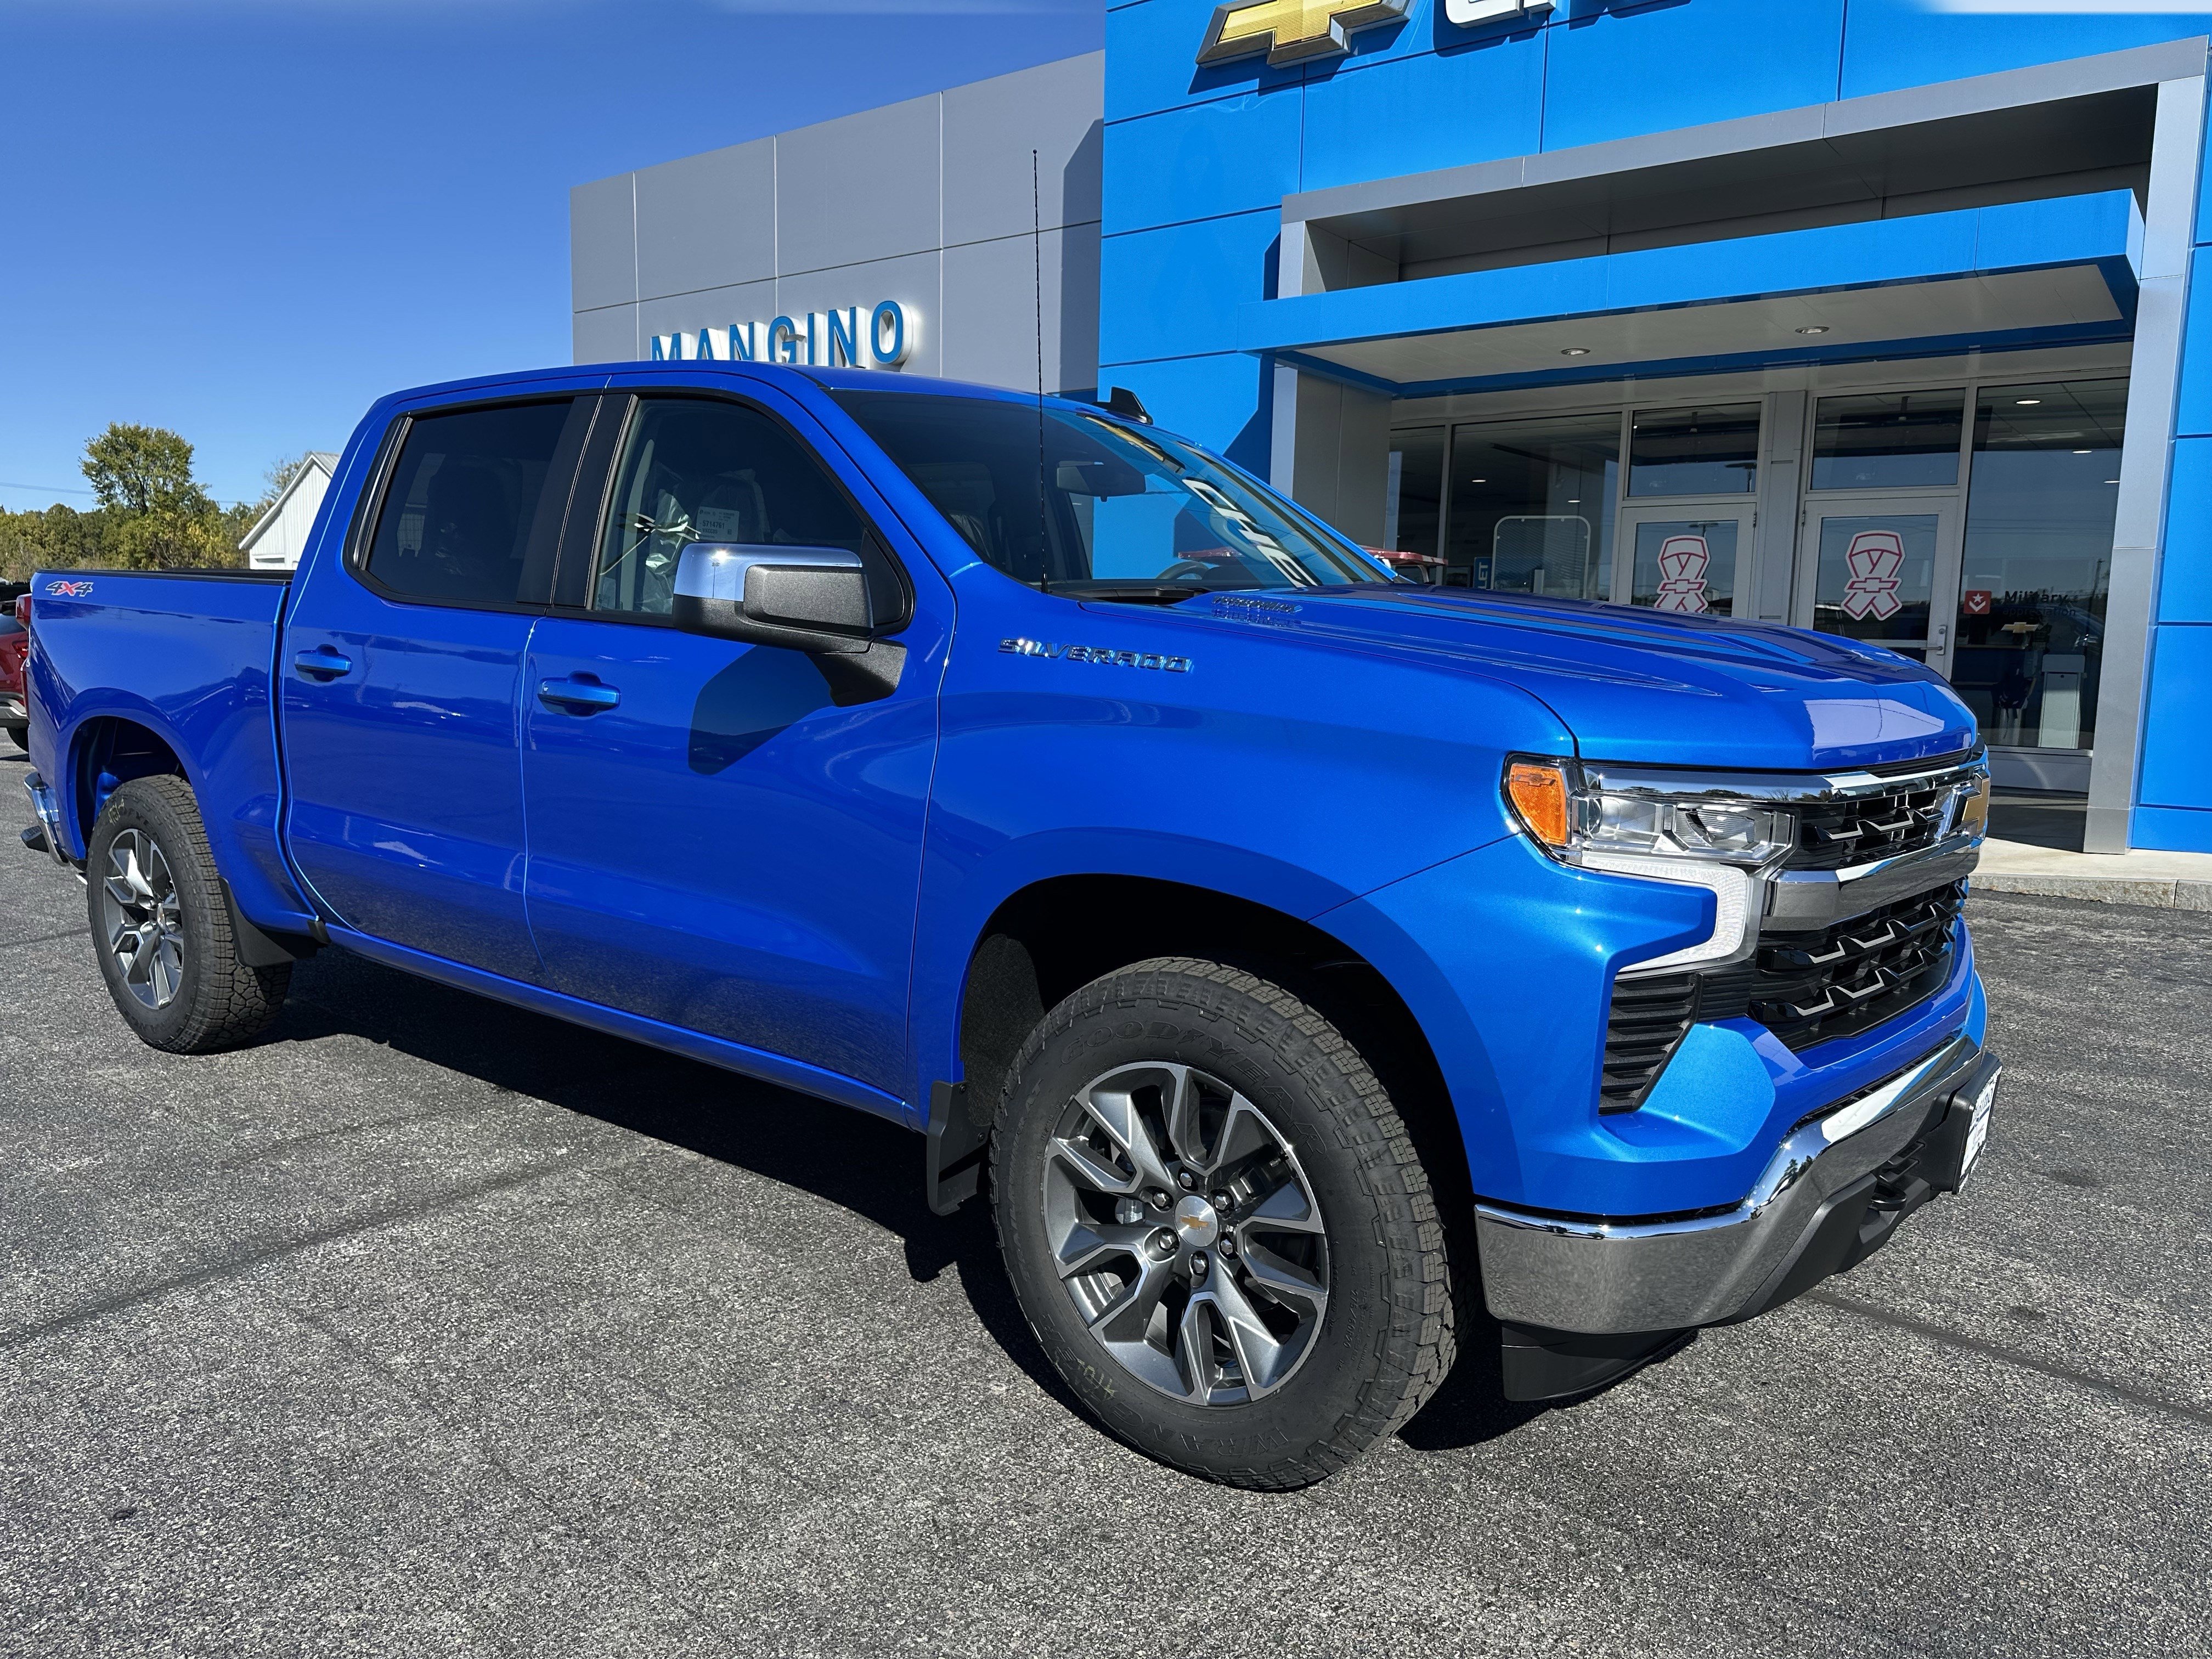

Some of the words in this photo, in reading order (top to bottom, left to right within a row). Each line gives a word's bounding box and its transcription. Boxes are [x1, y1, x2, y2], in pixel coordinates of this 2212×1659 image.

[651, 300, 906, 366] MANGINO
[2004, 591, 2068, 605] Military
[997, 638, 1192, 673] SILVERADO
[1060, 1020, 1327, 1155] GOODYEAR
